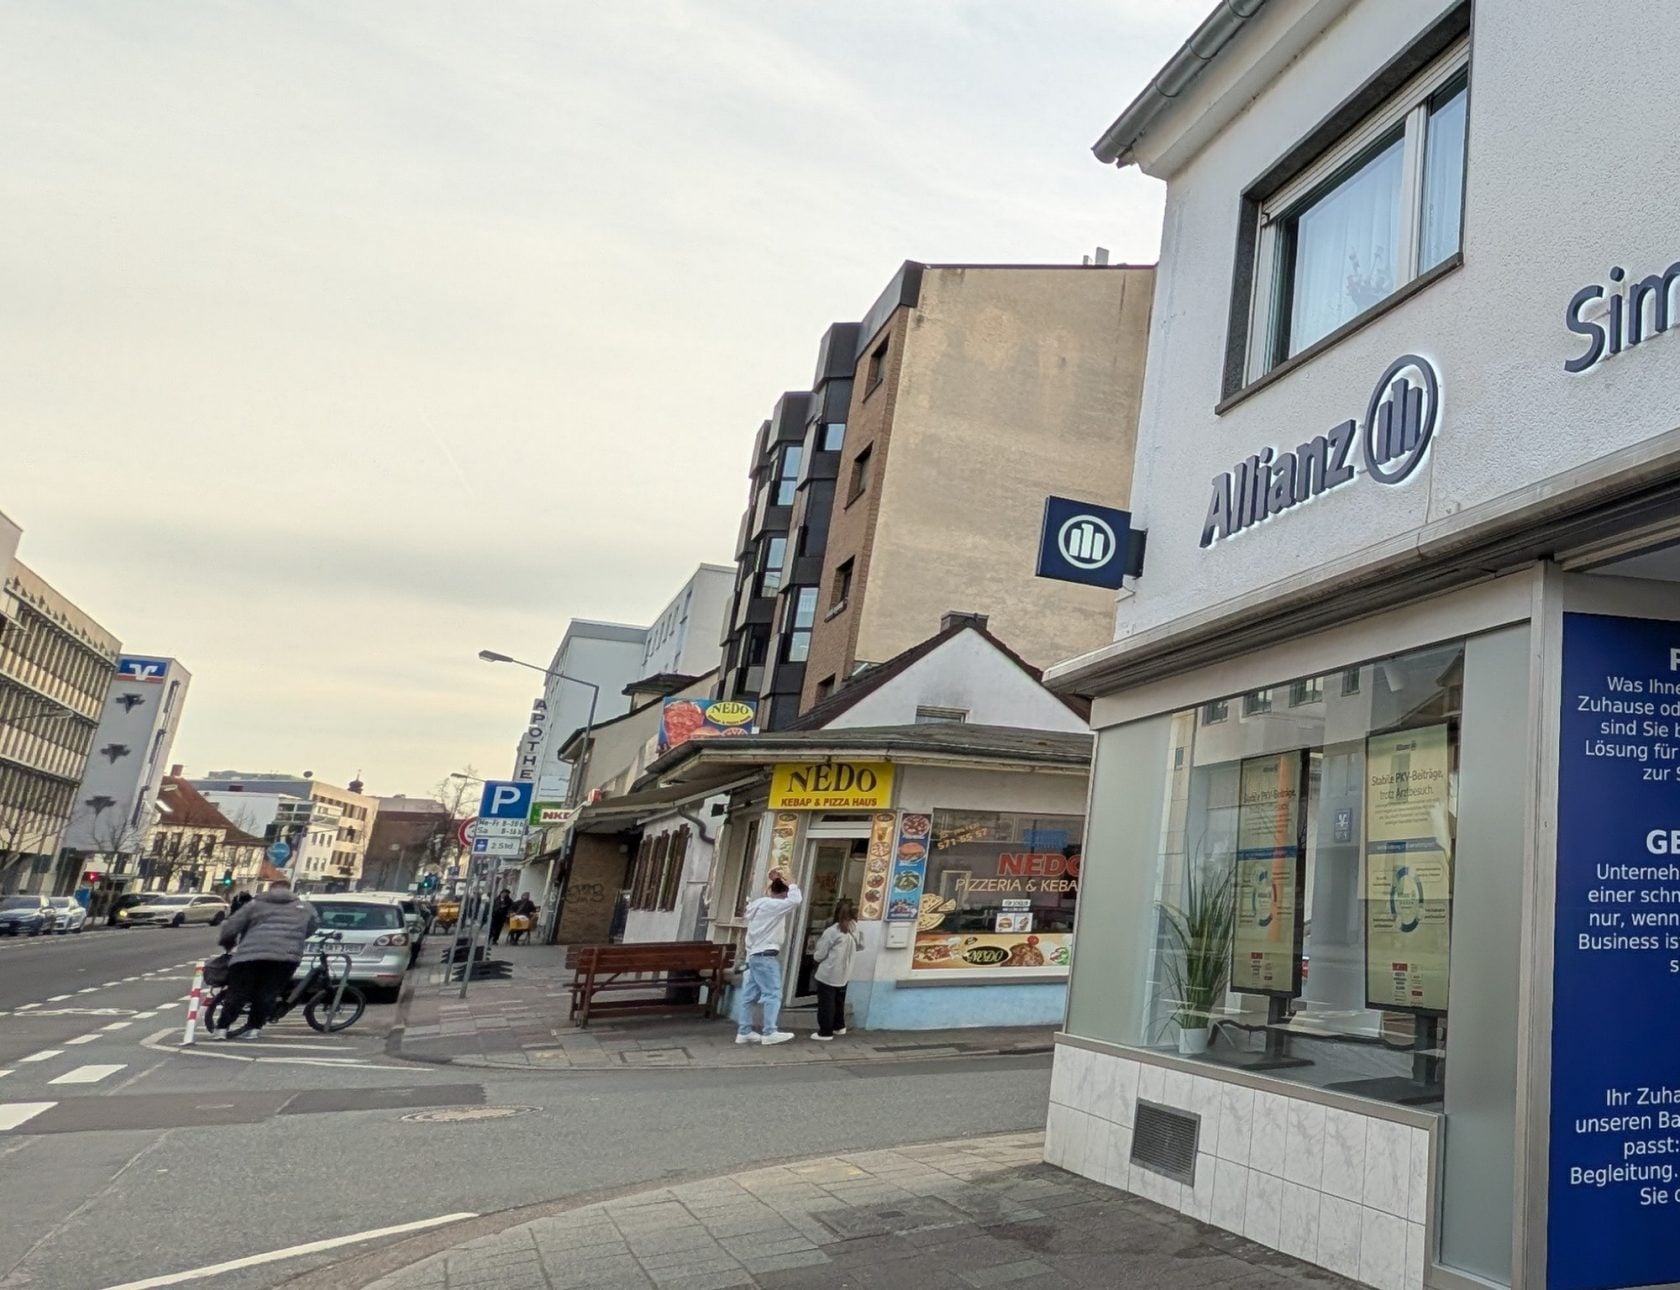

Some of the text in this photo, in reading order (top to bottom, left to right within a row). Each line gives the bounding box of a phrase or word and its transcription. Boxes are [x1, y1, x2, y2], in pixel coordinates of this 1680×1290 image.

[1199, 418, 1357, 548] Allianz
[1607, 676, 1643, 693] Was
[711, 703, 750, 715] NEDO
[1578, 696, 1654, 715] Zuhause
[519, 700, 548, 780] APOTHE
[1586, 740, 1648, 761] Lösung
[1654, 743, 1679, 759] für
[787, 763, 878, 793] NEDO
[1643, 768, 1671, 780] zur
[491, 786, 521, 815] P
[781, 797, 878, 807] KEBAP & PIZZA HAUS
[955, 879, 1022, 892] PIZZERIA
[1025, 879, 1037, 892] &
[1588, 886, 1635, 902] einer
[1579, 933, 1659, 949] Business
[1607, 1088, 1631, 1106] Ihr
[1576, 1116, 1651, 1133] unseren
[1624, 1137, 1679, 1160] passt:
[1571, 1163, 1678, 1187] Begleitung.
